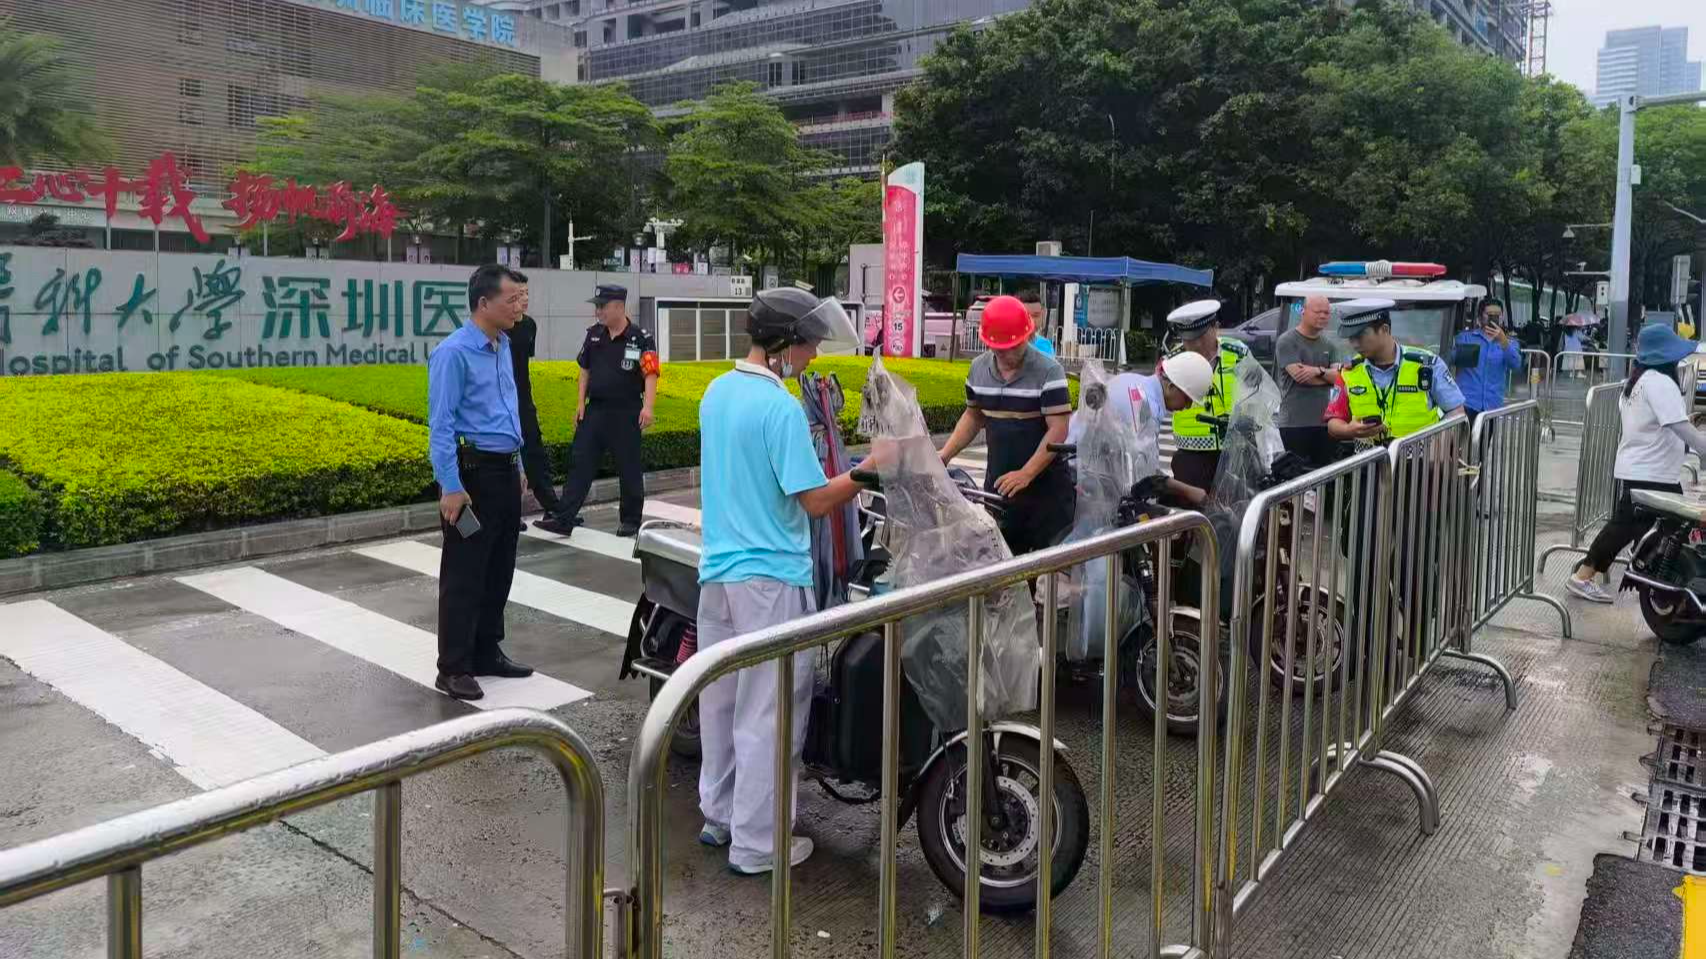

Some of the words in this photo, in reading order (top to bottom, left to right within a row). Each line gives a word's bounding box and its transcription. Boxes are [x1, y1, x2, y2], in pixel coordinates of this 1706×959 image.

[147, 345, 180, 370] of
[188, 343, 318, 369] Southern
[327, 342, 417, 366] Medical
